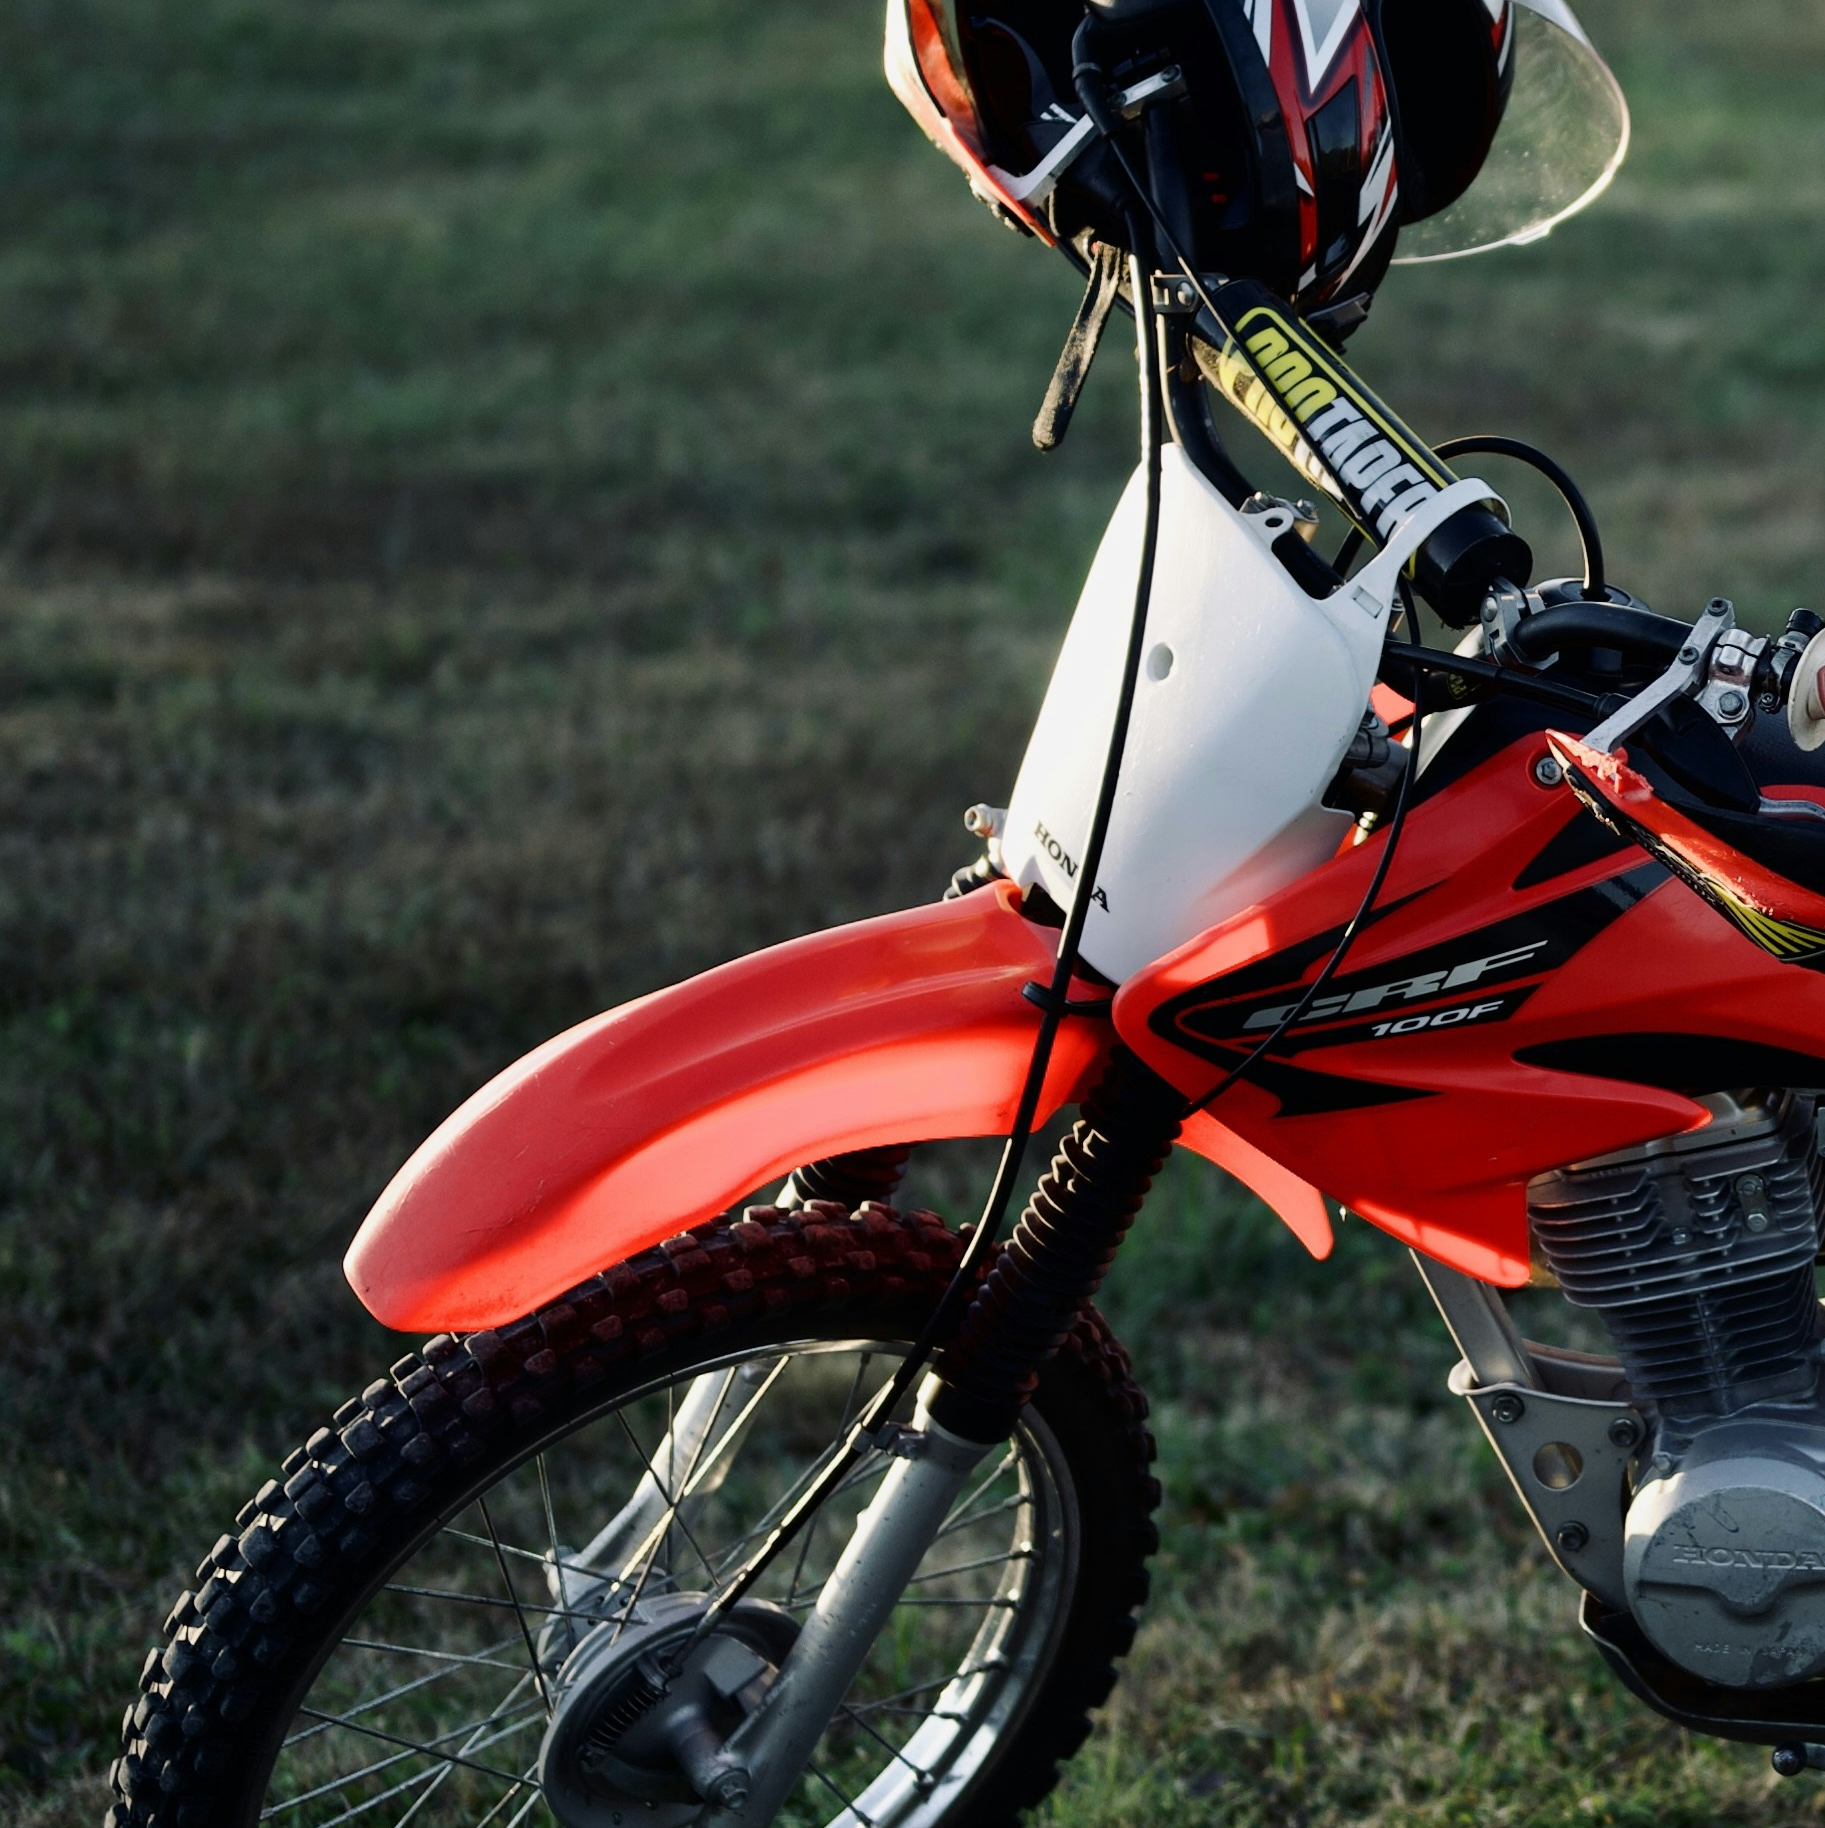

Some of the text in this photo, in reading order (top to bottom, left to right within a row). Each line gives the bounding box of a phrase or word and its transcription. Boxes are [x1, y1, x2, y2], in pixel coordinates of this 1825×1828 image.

[1033, 820, 1110, 914] HONA
[1241, 939, 1549, 1030] CRF
[1370, 999, 1504, 1038] 100F
